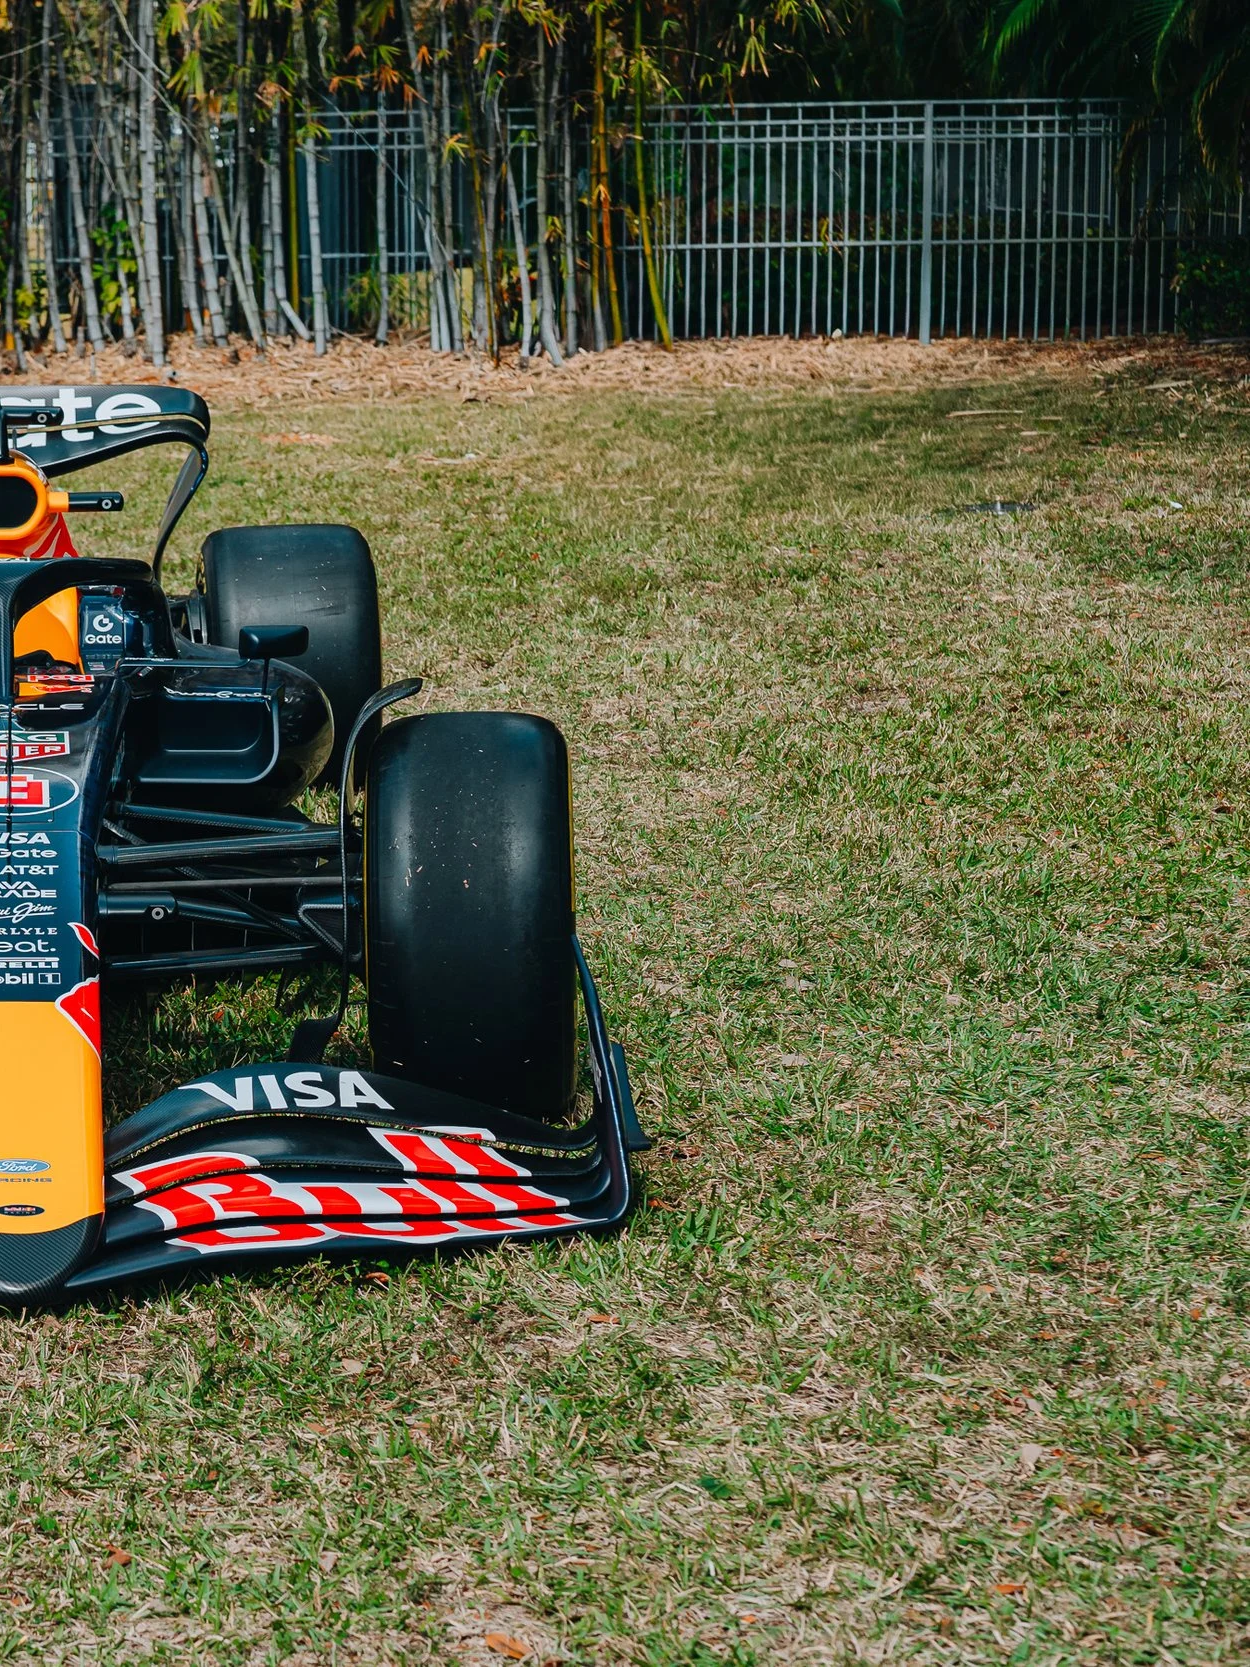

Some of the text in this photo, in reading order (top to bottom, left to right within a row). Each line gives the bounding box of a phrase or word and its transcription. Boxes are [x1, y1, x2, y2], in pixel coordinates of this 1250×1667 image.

[85, 634, 122, 644] Gate
[0, 865, 59, 875] AT&T
[11, 902, 58, 924] Jim
[178, 1071, 394, 1112] VISA
[113, 1126, 607, 1253] Bull
